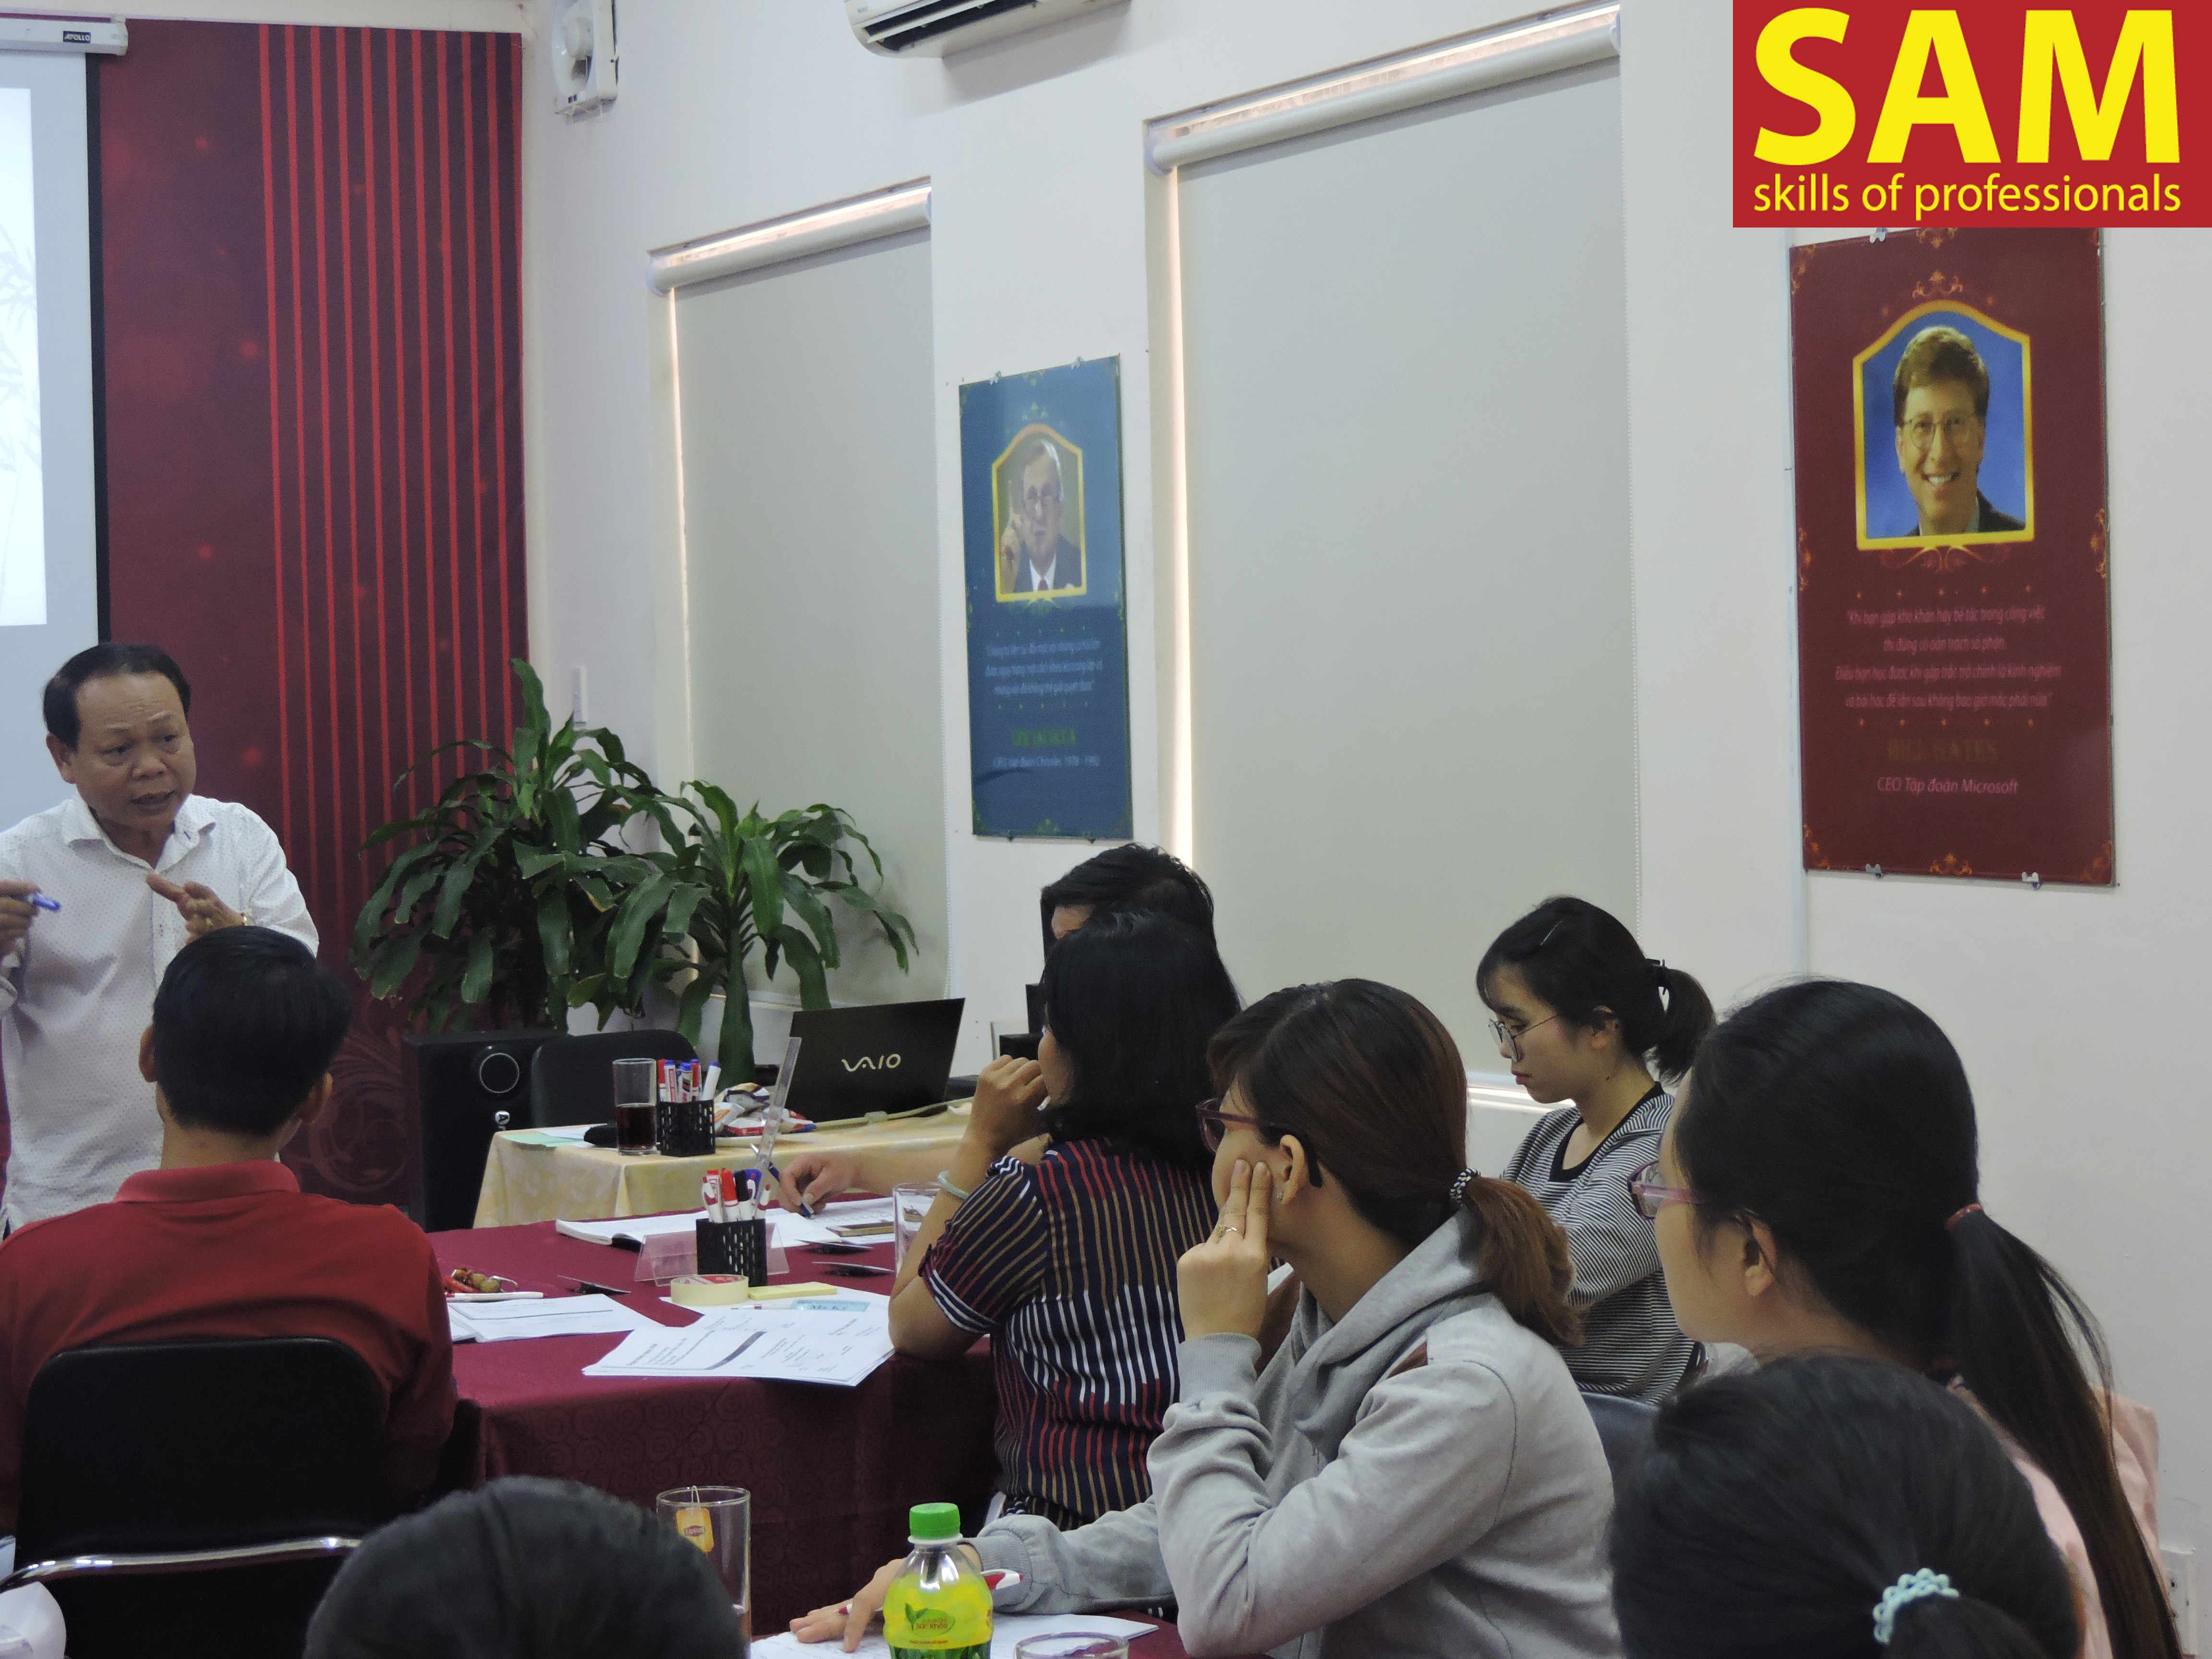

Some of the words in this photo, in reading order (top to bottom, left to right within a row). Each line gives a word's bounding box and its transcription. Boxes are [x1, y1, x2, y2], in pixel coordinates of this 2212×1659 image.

[1877, 777, 1901, 792] CEO
[1961, 778, 2019, 794] Microsoft
[841, 1053, 901, 1072] VAIO
